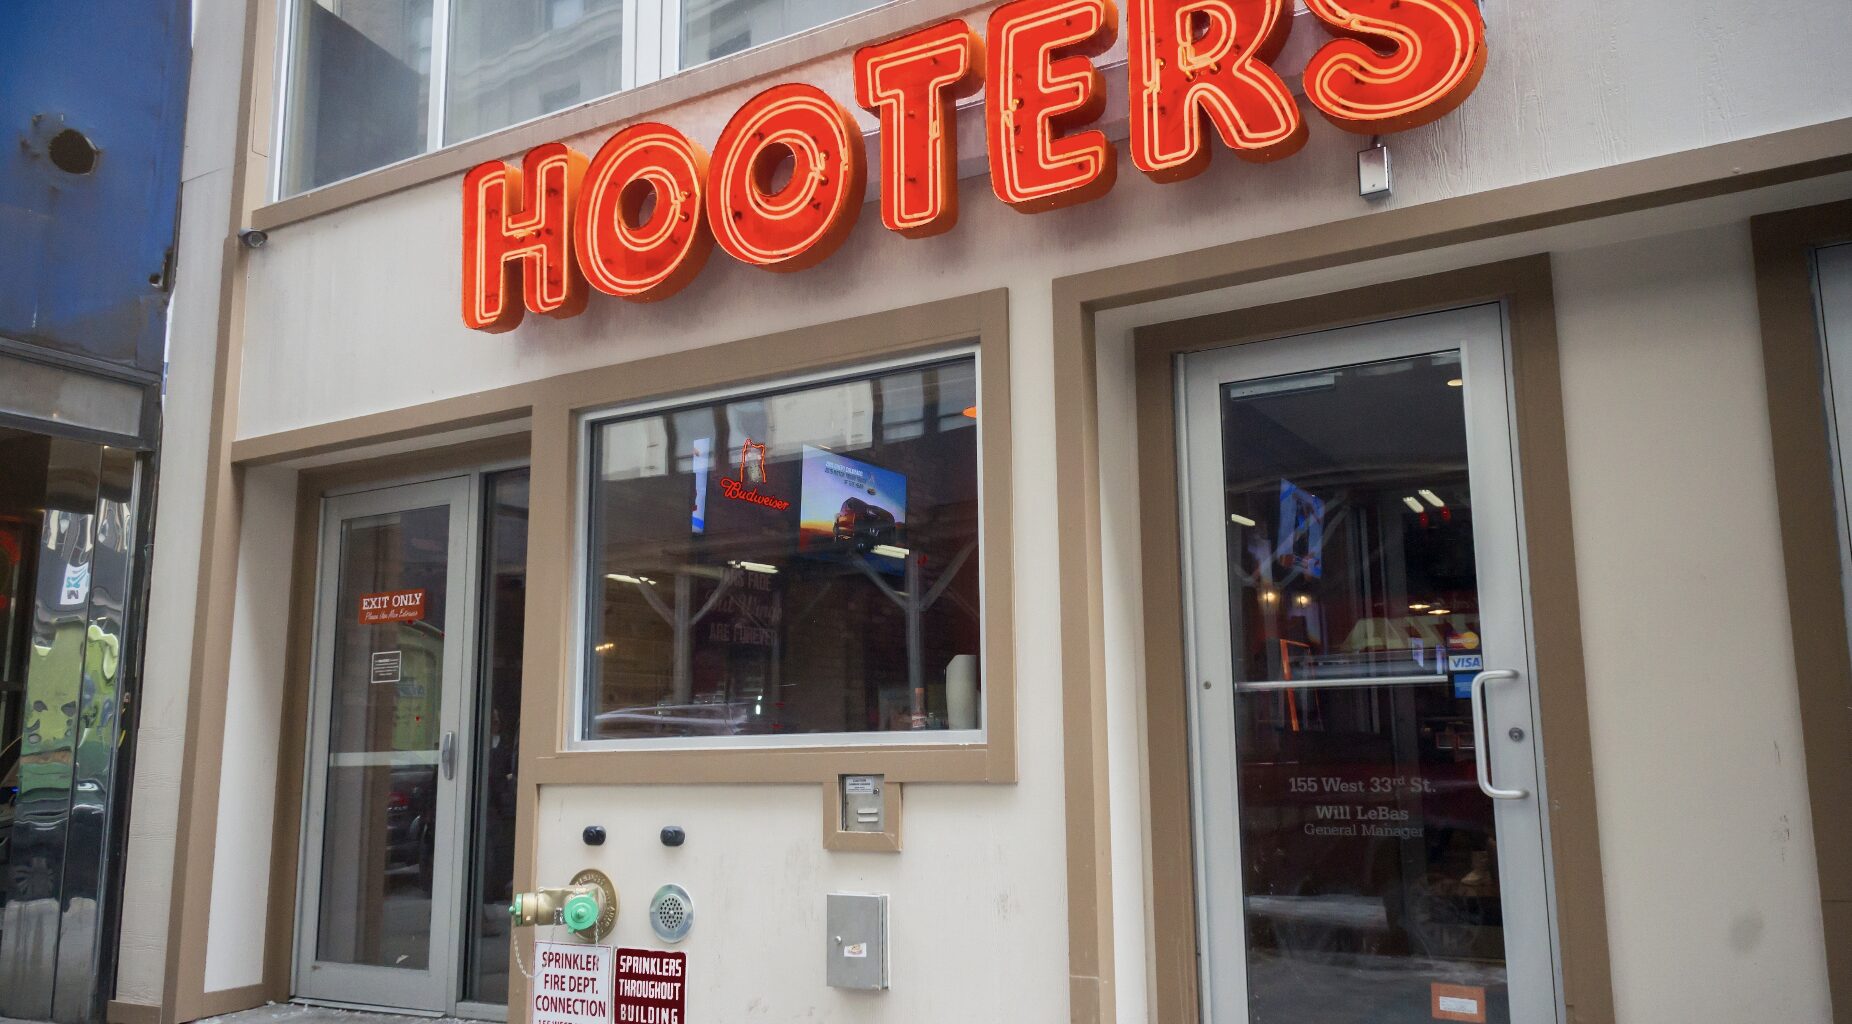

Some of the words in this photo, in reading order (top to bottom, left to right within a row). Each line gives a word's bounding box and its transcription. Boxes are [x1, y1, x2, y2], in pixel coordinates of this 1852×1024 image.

[461, 0, 1487, 334] HOOTERS
[721, 477, 789, 510] Budweiser
[362, 596, 390, 610] EXIT
[392, 593, 422, 608] ONLY
[1453, 657, 1480, 668] VISA
[1289, 777, 1318, 792] 155
[1321, 777, 1365, 792] West
[1370, 775, 1405, 793] 33rd
[1410, 777, 1437, 793] St.
[1315, 805, 1349, 819] Will
[1356, 806, 1409, 820] LeBas
[1304, 823, 1356, 836] General
[1361, 823, 1424, 840] Manager
[541, 951, 599, 972] SPRINKLER
[619, 955, 682, 977] SPRINKLERS
[544, 973, 566, 991] FIRE
[568, 976, 599, 995] DEPT.
[619, 979, 681, 1001] THROUGHOUT
[535, 994, 606, 1018] CONNECTION
[620, 1003, 678, 1024] BUILDING
